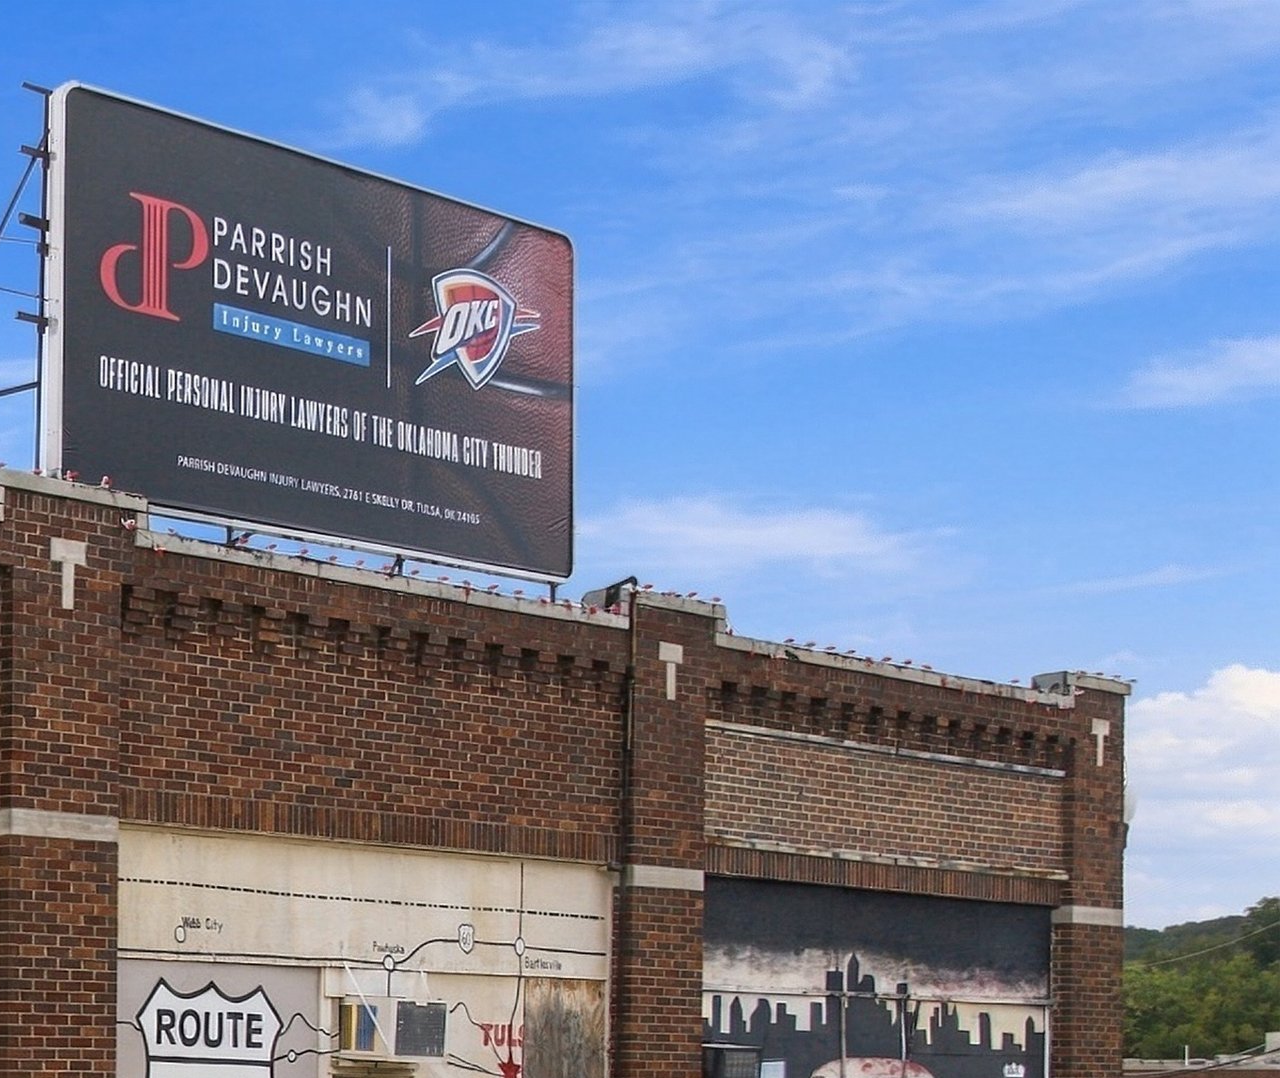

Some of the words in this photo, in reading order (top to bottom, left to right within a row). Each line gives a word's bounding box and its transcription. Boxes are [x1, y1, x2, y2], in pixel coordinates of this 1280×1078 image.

[214, 217, 331, 276] PARRISH
[214, 258, 371, 327] DEVAUGHN
[222, 310, 282, 341] Injury
[293, 327, 364, 359] Lawyers
[437, 299, 501, 355] OKC
[99, 355, 162, 399] OFFICIAL
[167, 369, 235, 414] PERSONAL
[240, 385, 287, 425] INJURY
[290, 396, 349, 439] LAWYERS
[352, 410, 368, 443] OF
[372, 415, 394, 448] THE
[397, 421, 459, 464] OKLAHOMA
[462, 436, 489, 469] CITY
[492, 442, 543, 480] THUNDER
[176, 454, 216, 474] PARRISH
[216, 462, 268, 483] DEVAUGHN
[269, 472, 300, 490] INJURY
[364, 492, 372, 504] E
[371, 493, 401, 509] SKELLY
[443, 508, 456, 522] OK
[205, 918, 224, 935] City
[155, 1007, 264, 1049] ROUTE
